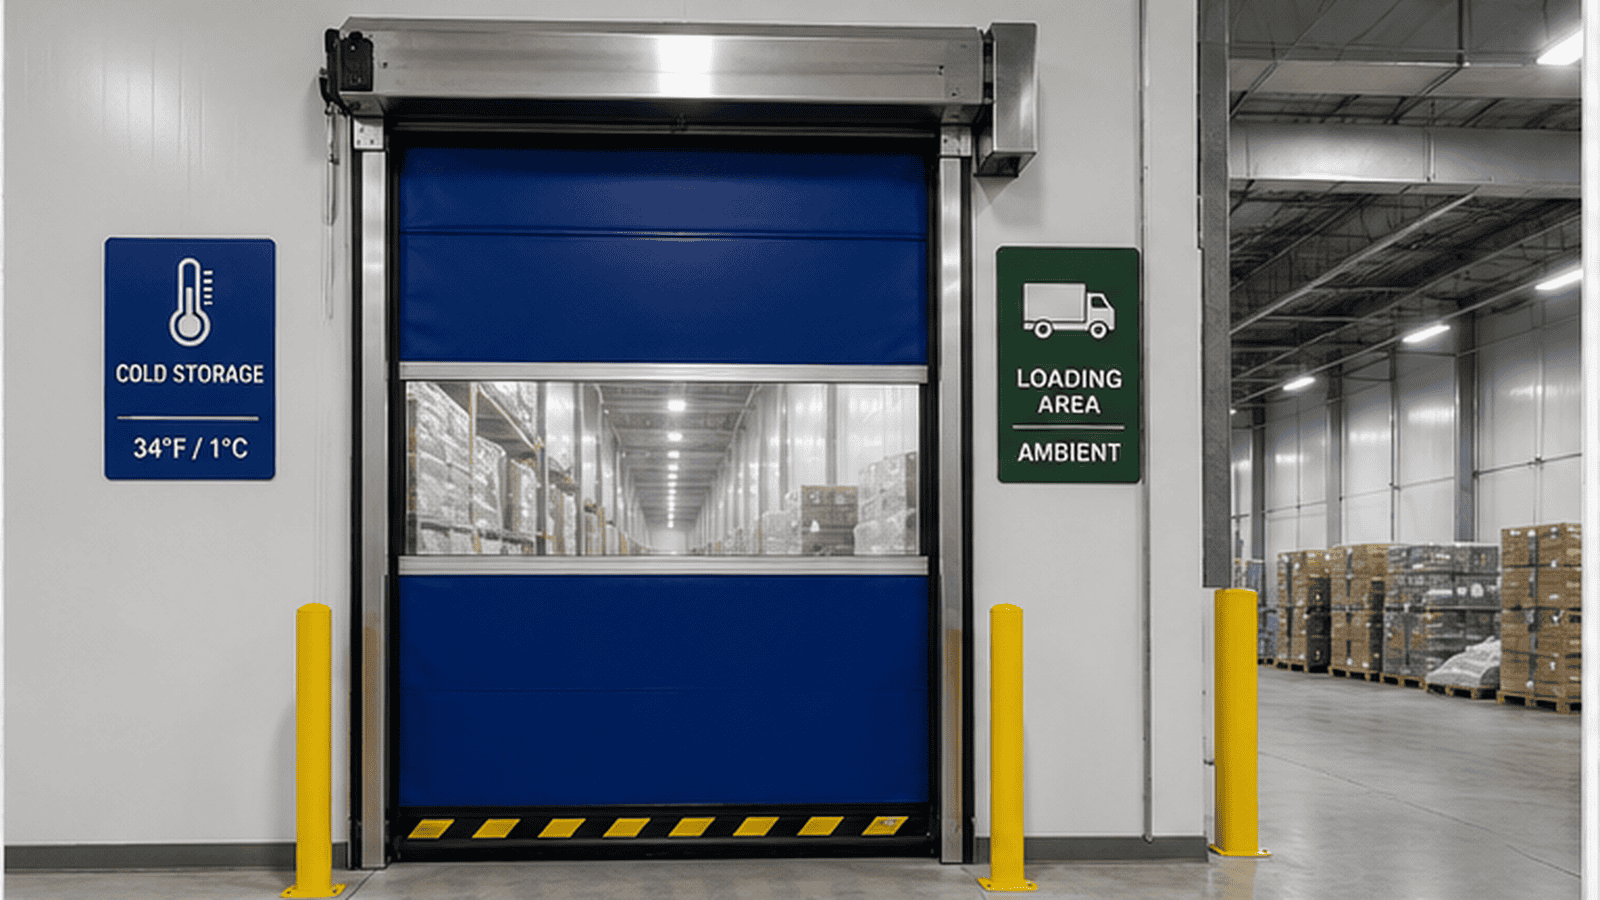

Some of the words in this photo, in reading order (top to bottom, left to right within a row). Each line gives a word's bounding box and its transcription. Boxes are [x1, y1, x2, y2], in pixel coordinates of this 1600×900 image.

[116, 364, 167, 383] COLD
[173, 364, 264, 383] STORAGE
[1017, 368, 1122, 388] LOADING
[1037, 395, 1101, 413] AREA
[133, 437, 187, 459] 34°F
[191, 437, 203, 460] /
[210, 437, 249, 459] 1°C
[1017, 442, 1121, 462] AMBIENT
